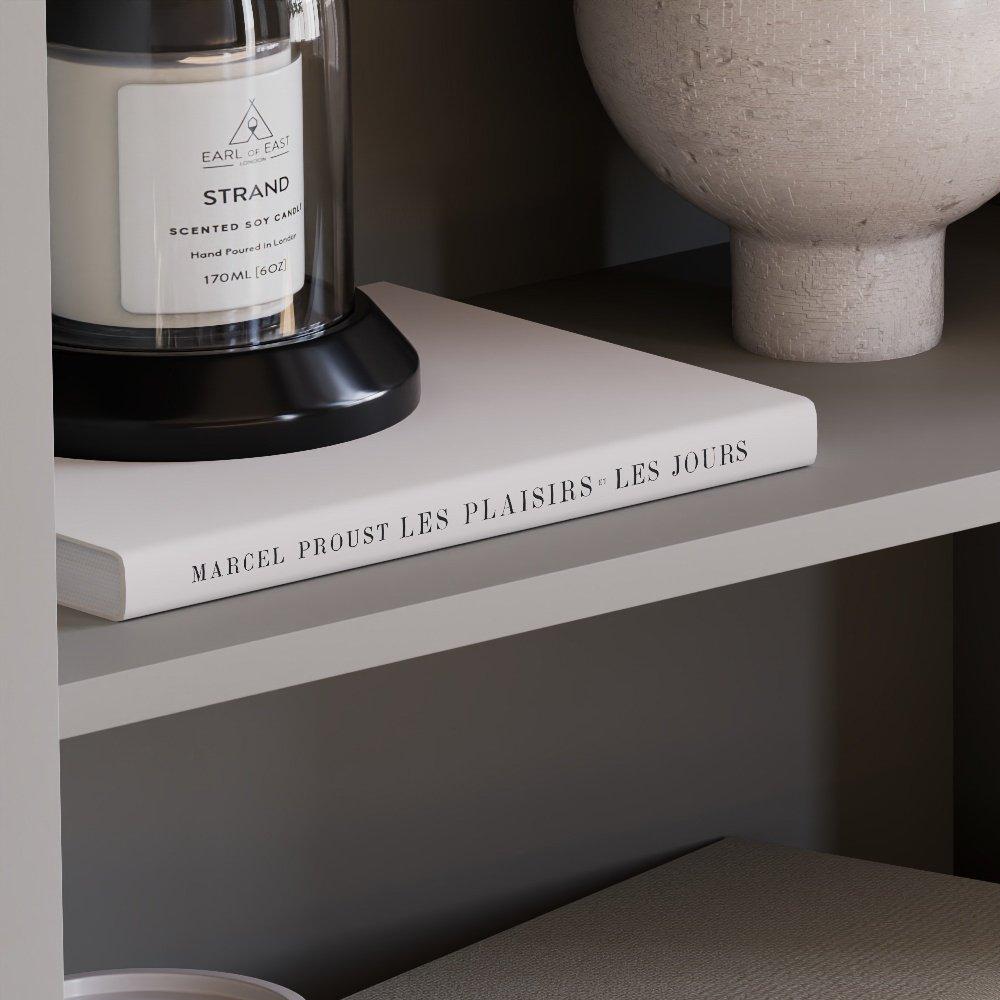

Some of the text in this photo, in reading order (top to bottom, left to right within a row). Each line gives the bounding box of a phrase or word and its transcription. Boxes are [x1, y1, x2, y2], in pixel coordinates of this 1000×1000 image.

[202, 135, 289, 163] EARL OF EAST
[203, 176, 289, 206] STRAND
[169, 223, 239, 236] SCENTED
[245, 216, 270, 229] SOY
[190, 249, 222, 260] Hand
[225, 243, 261, 256] Poured
[263, 242, 272, 250] in
[204, 270, 251, 285] 170ML
[191, 546, 285, 584] MARCEL
[298, 522, 389, 560] PROUST
[400, 508, 449, 540] LES
[464, 475, 593, 525] PLAISIRS
[615, 459, 660, 490] LES
[671, 439, 749, 477] JOURS
